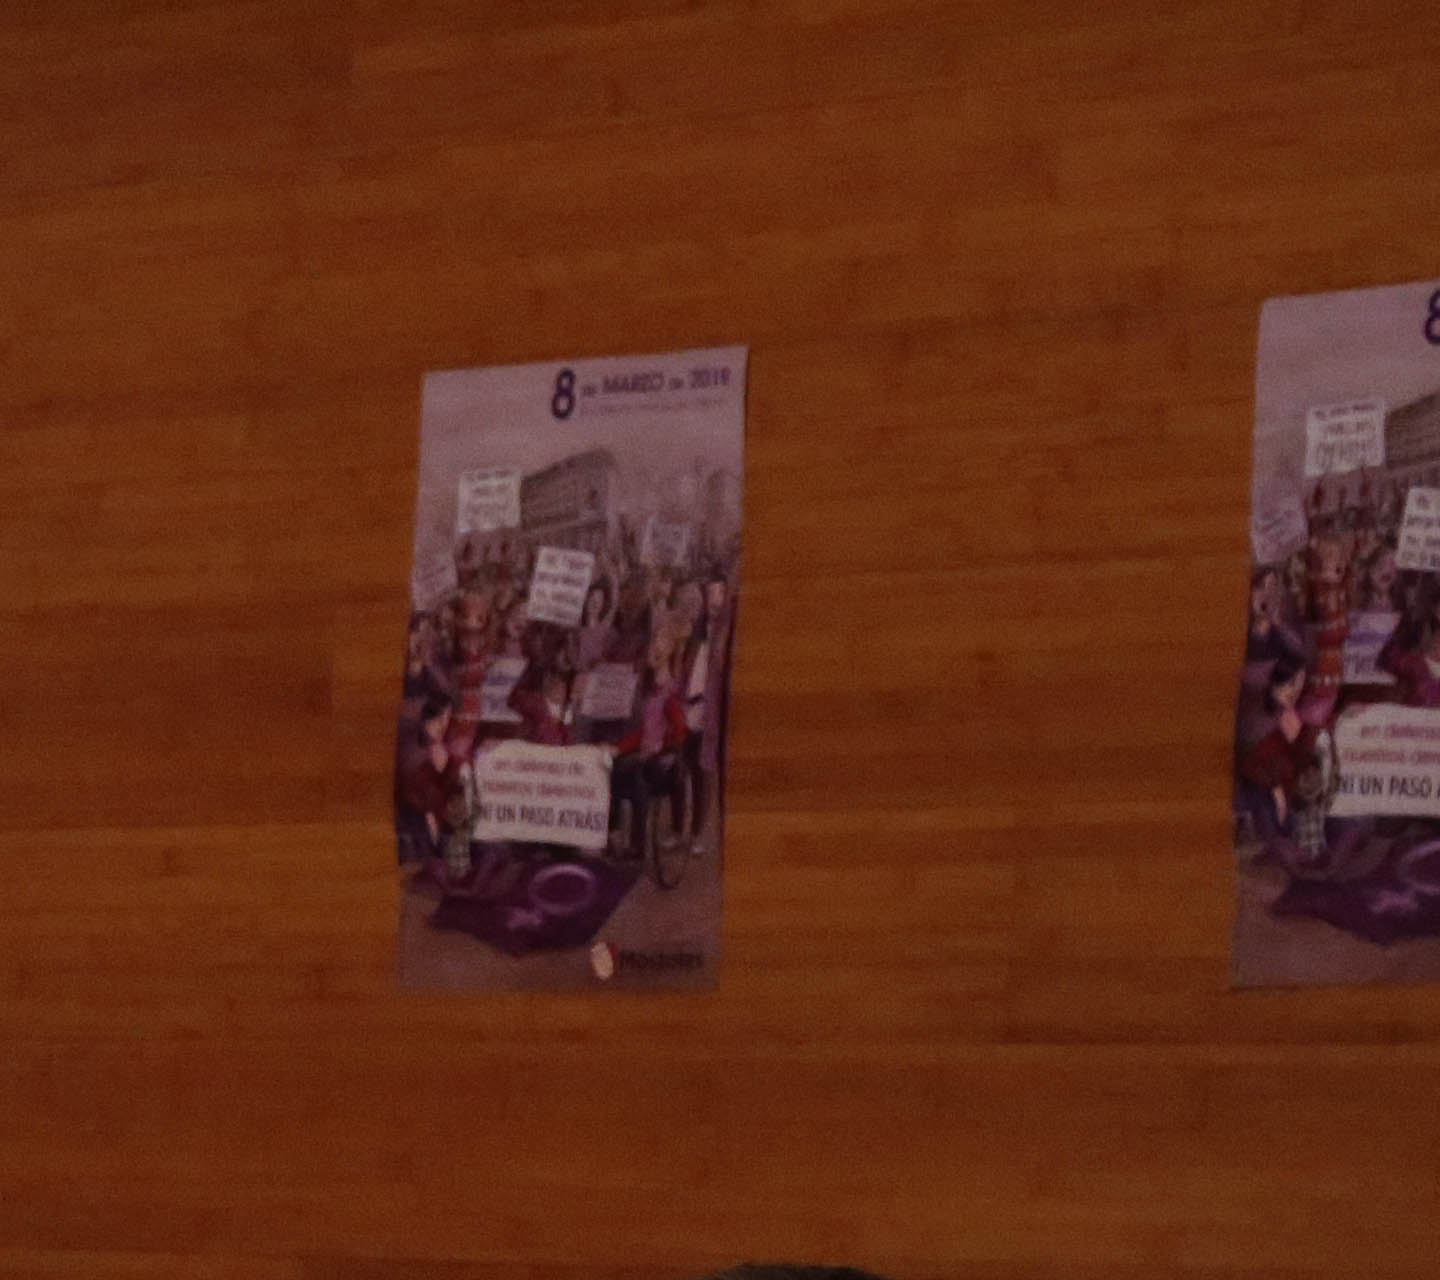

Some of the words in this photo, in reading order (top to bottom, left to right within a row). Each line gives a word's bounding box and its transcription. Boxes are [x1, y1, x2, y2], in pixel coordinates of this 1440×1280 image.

[551, 367, 576, 419] 8
[1359, 775, 1384, 795] UN
[1389, 775, 1433, 800] PASO
